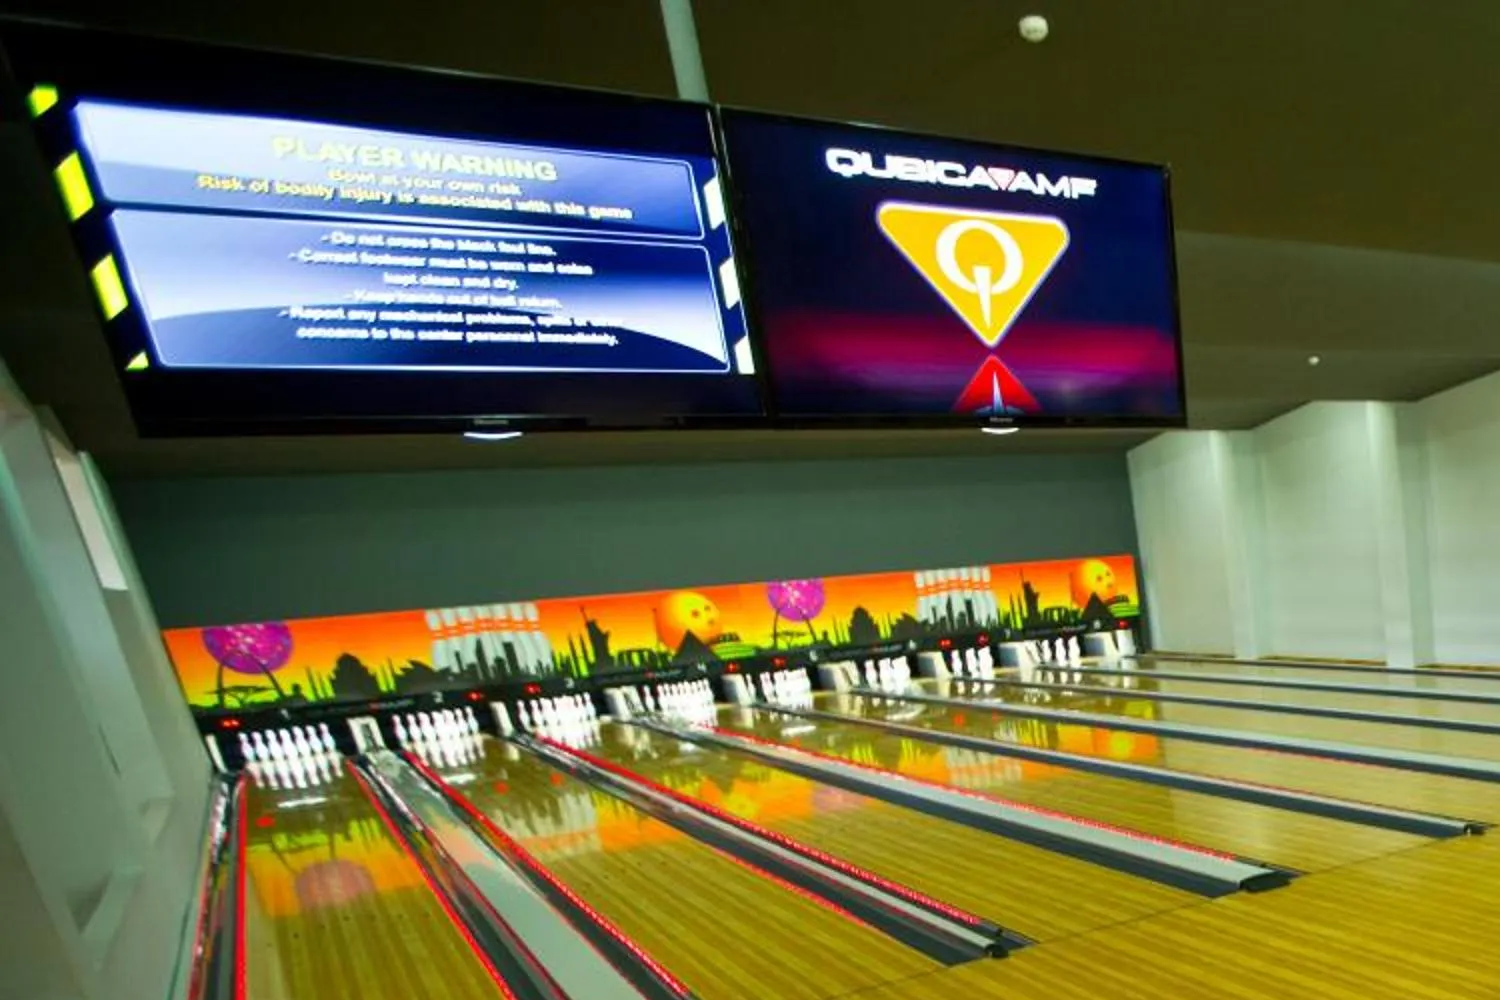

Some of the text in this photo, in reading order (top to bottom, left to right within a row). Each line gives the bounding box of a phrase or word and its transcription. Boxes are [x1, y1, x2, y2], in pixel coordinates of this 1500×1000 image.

[272, 134, 557, 181] PLAYER WARNING
[197, 174, 243, 191] Risk
[250, 179, 269, 193] of
[275, 180, 335, 200] bodily
[516, 198, 551, 213] with
[555, 200, 585, 215] this
[402, 175, 442, 190] your
[448, 180, 484, 193] own
